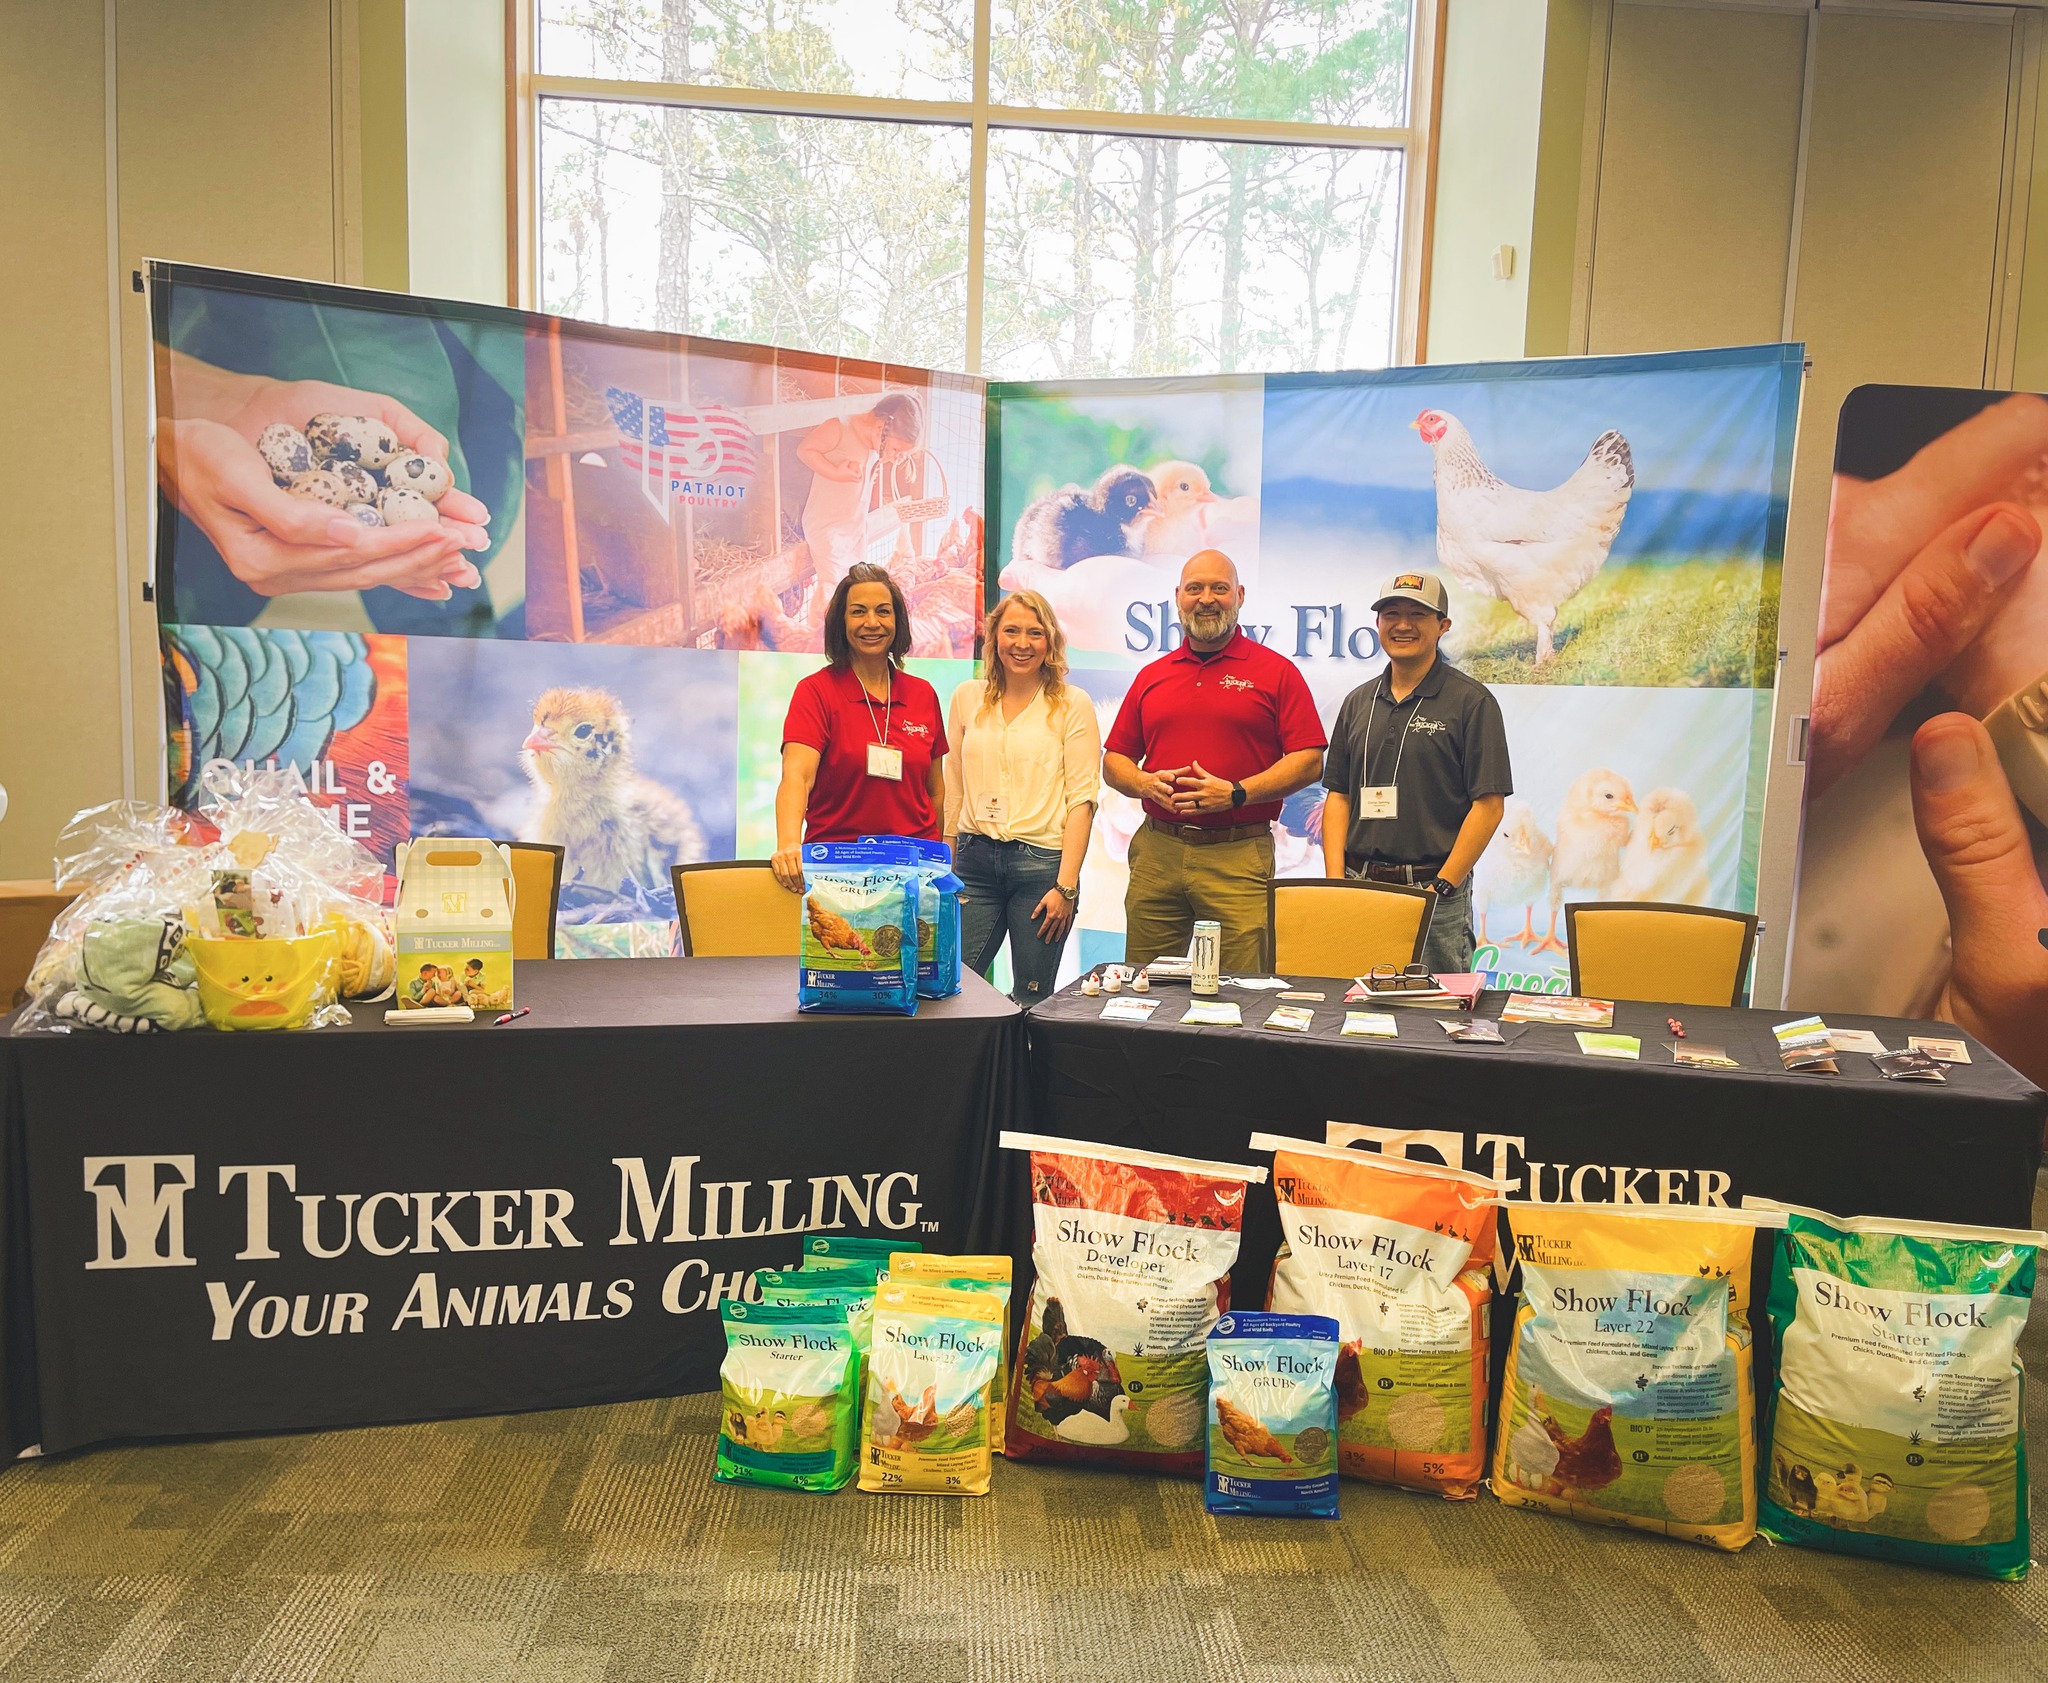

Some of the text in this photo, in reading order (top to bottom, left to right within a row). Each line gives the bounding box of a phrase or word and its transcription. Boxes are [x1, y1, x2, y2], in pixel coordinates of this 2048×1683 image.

[671, 480, 745, 498] PATRIOT
[679, 495, 738, 509] POULTRY
[1125, 600, 1273, 653] Shw
[366, 760, 397, 795] &
[862, 872, 906, 888] Flock
[425, 937, 494, 949] TUCKER MILLING
[817, 971, 836, 980] TUCKER
[816, 980, 836, 988] MILLING
[818, 991, 892, 1000] 34% 30%
[1476, 1132, 1733, 1208] TUCKER
[1296, 1177, 1331, 1193] TUCKER
[1297, 1192, 1328, 1207] MILLING
[218, 1164, 584, 1261] TUCKER
[608, 1155, 923, 1246] MILLING
[1056, 1219, 1201, 1264] Show Flock
[1298, 1224, 1435, 1273] Show Flock
[1535, 1234, 1572, 1250] TUCKER
[1086, 1249, 1166, 1273] Developer
[1537, 1251, 1573, 1267] MILLING
[1337, 1255, 1394, 1281] Layer 17
[1356, 1275, 1371, 1283] Feed
[1371, 1279, 1399, 1294] Formulated
[204, 1258, 805, 1341] YOUR ANIMALS CHO
[1552, 1286, 1692, 1317] Show Flock
[1814, 1281, 1988, 1329] Show Flock
[1594, 1318, 1655, 1336] Layer 22
[1871, 1323, 1931, 1347] Starter
[738, 1334, 838, 1351] Show Flock
[885, 1325, 986, 1353] Show Flock
[1831, 1332, 1860, 1344] Premium
[1861, 1338, 1877, 1347] Feed
[769, 1350, 804, 1361] Starter
[1373, 1348, 1386, 1356] BIO
[1852, 1345, 1876, 1356] Chicks,
[1876, 1349, 1908, 1363] Ducklings,
[1222, 1354, 1324, 1374] Show Flock
[1253, 1376, 1297, 1389] GRUBS
[1953, 1373, 1986, 1382] Technology
[1630, 1424, 1643, 1433] BIO
[881, 1451, 902, 1462] TUCKER
[1344, 1450, 1445, 1475] 3% 5%
[733, 1465, 754, 1478] 21%
[881, 1472, 903, 1483] 22%
[792, 1475, 809, 1485] 4%
[945, 1476, 961, 1485] 3%
[1229, 1477, 1252, 1489] TUCKER
[1229, 1487, 1252, 1498] MILLING
[1521, 1497, 1717, 1546] 22% 4%
[1966, 1550, 1991, 1562] 4%
